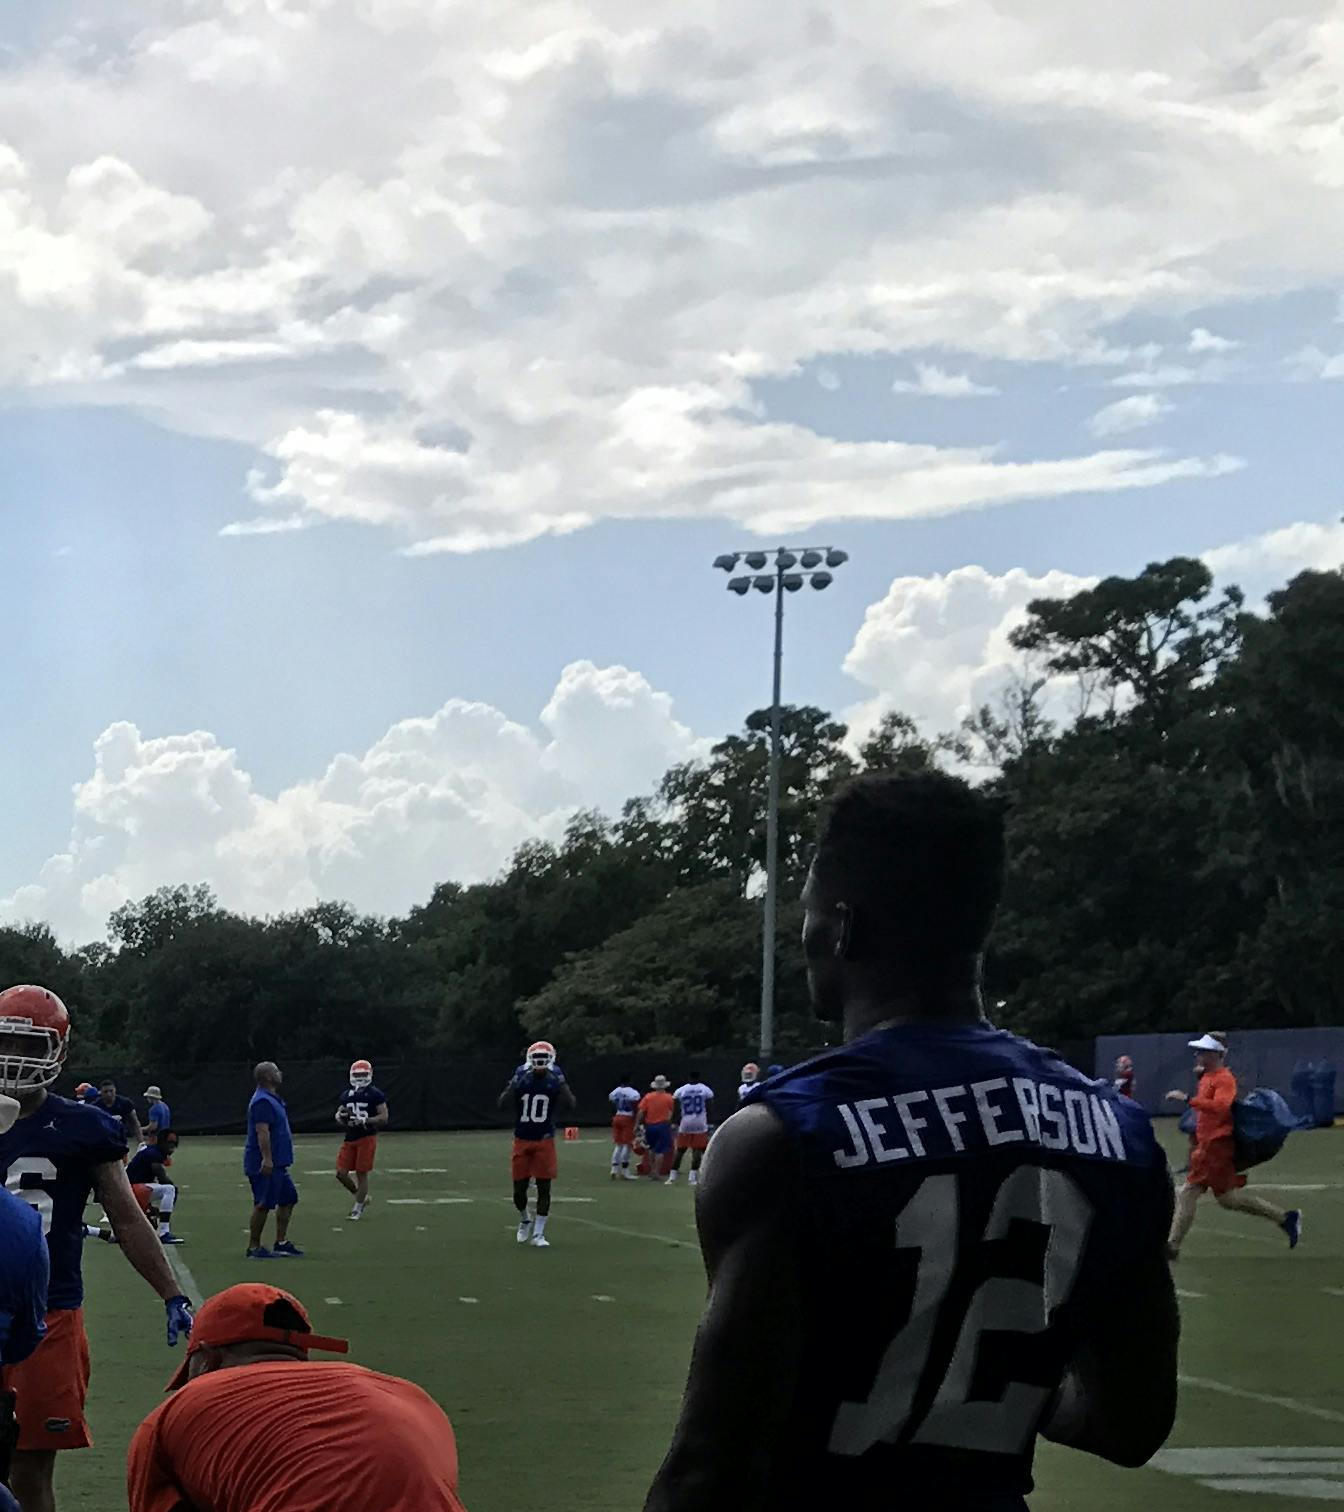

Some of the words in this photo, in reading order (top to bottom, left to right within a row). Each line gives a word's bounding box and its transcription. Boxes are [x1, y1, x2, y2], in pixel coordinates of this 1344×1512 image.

[520, 1094, 550, 1123] 10
[682, 1095, 703, 1115] 28
[832, 1077, 1127, 1168] JEFFERSON
[825, 1163, 1096, 1457] 12
